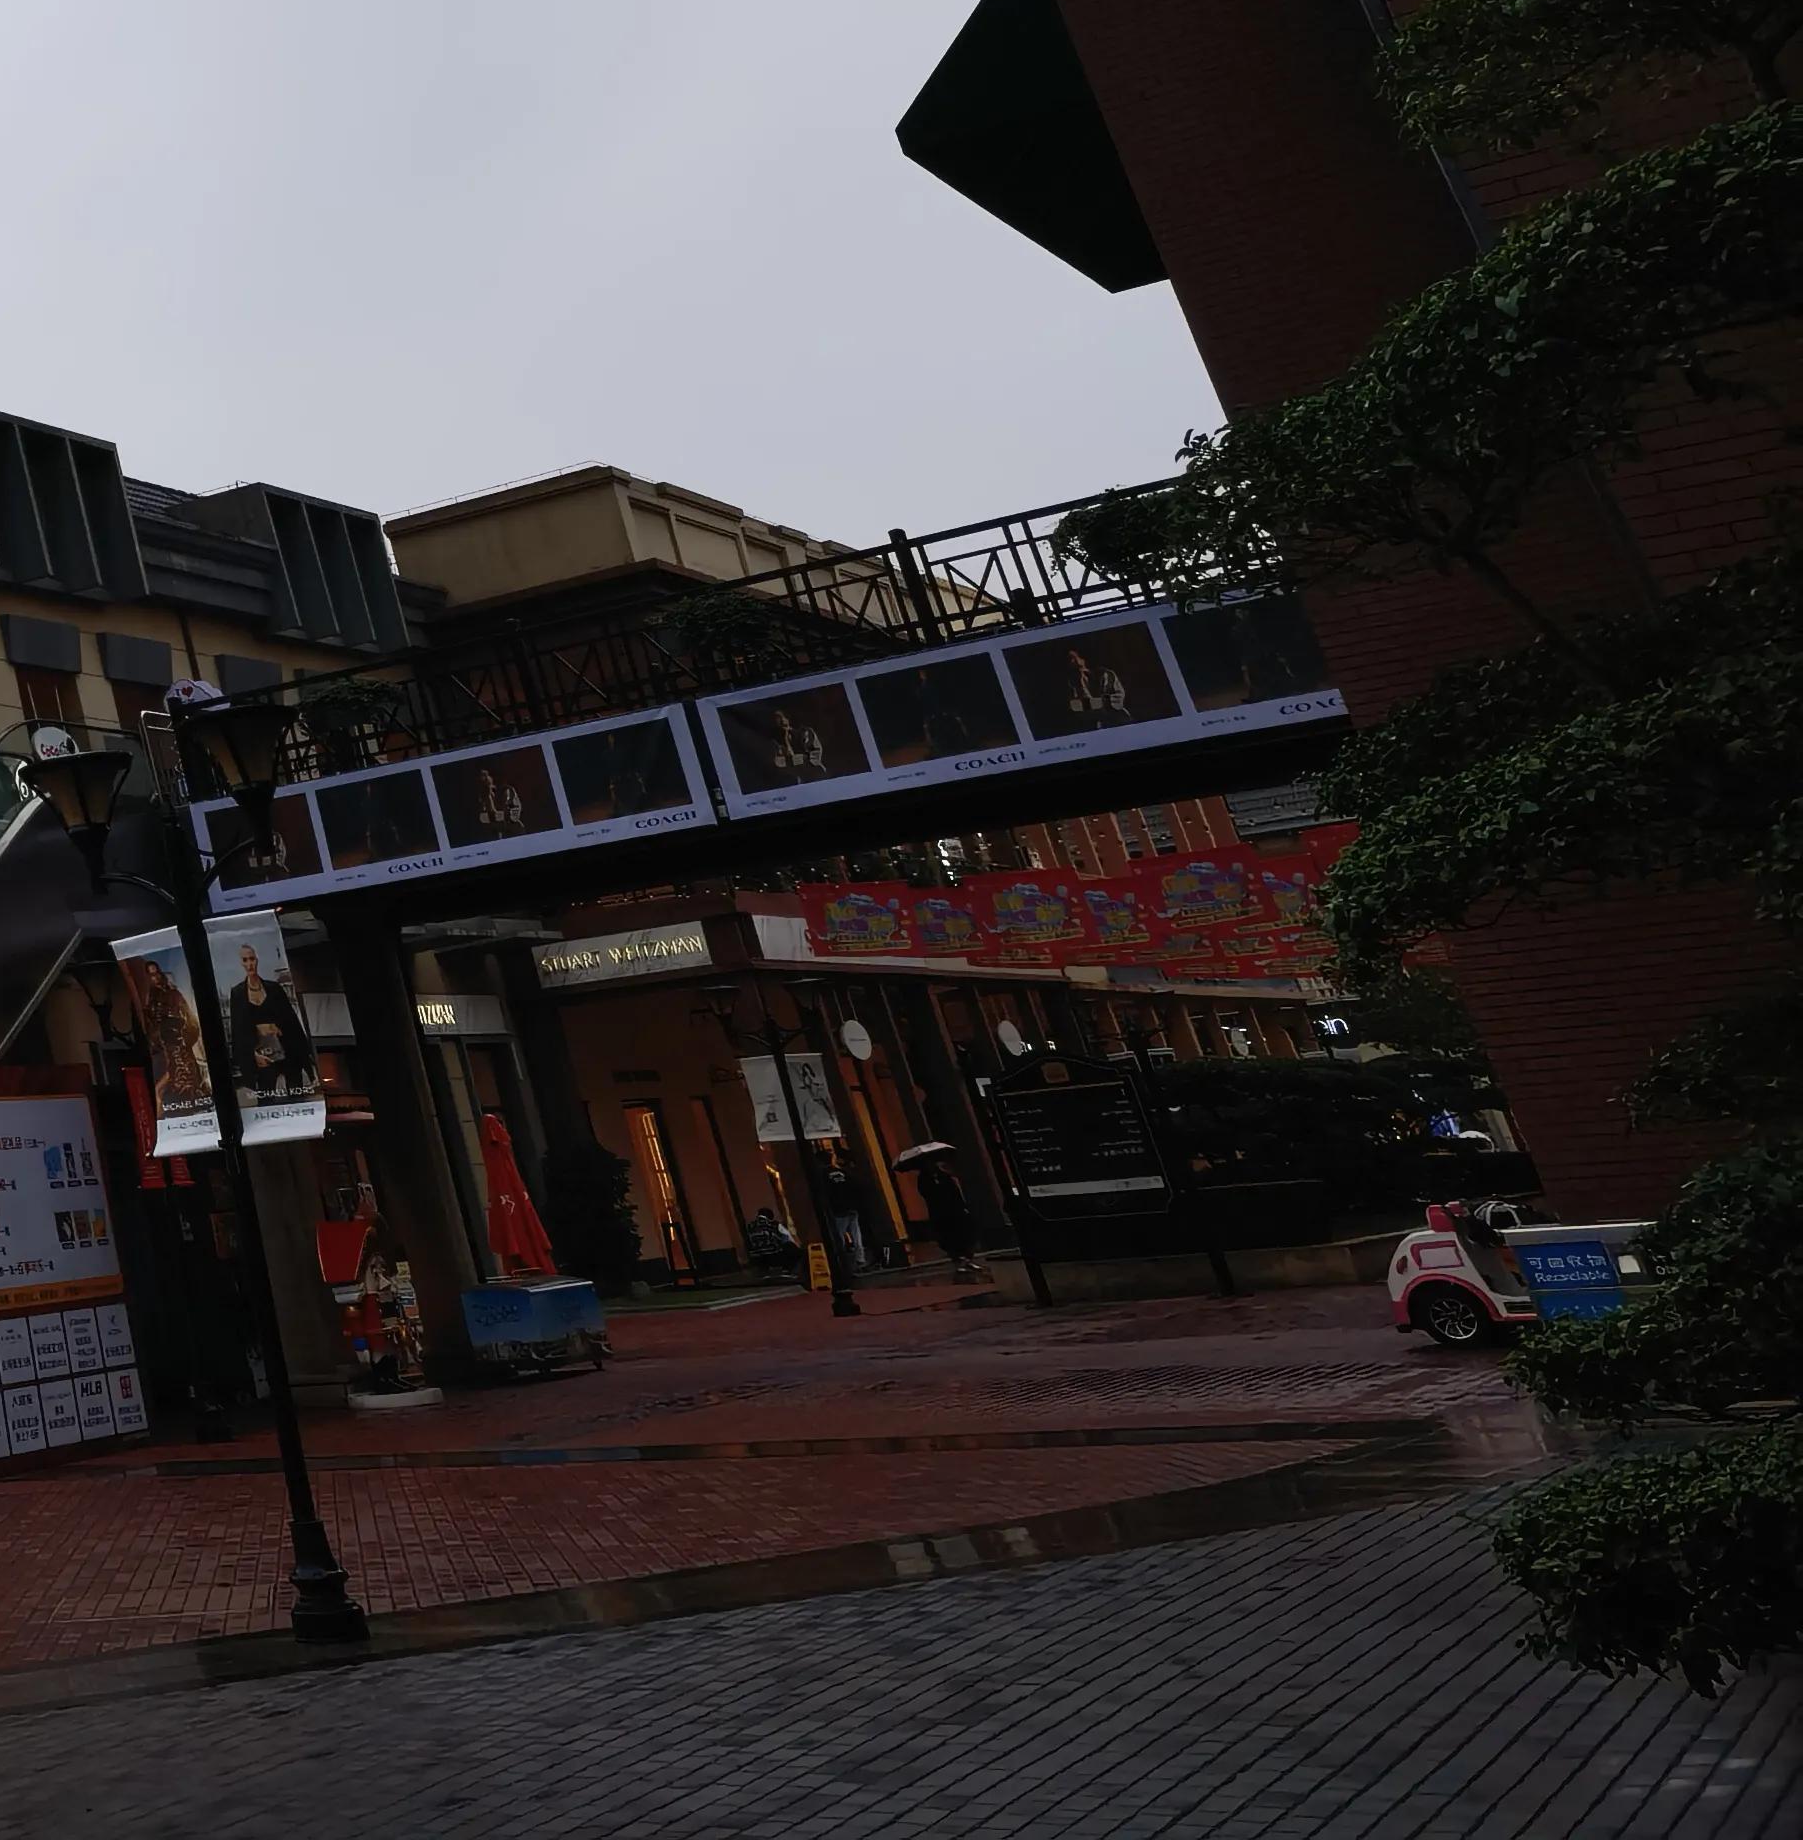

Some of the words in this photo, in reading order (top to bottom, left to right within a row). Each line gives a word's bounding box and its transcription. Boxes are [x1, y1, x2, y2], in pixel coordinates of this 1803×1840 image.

[1279, 696, 1344, 716] COAC
[954, 751, 1026, 772] COACH
[635, 810, 697, 829] COACH
[387, 857, 444, 874] COACH
[541, 950, 601, 974] STUART
[607, 935, 704, 965] WEITZMAN
[289, 1085, 316, 1096] KORS
[162, 1100, 193, 1112] MICHAEL
[194, 1096, 214, 1106] KORS
[81, 1380, 103, 1398] MLB
